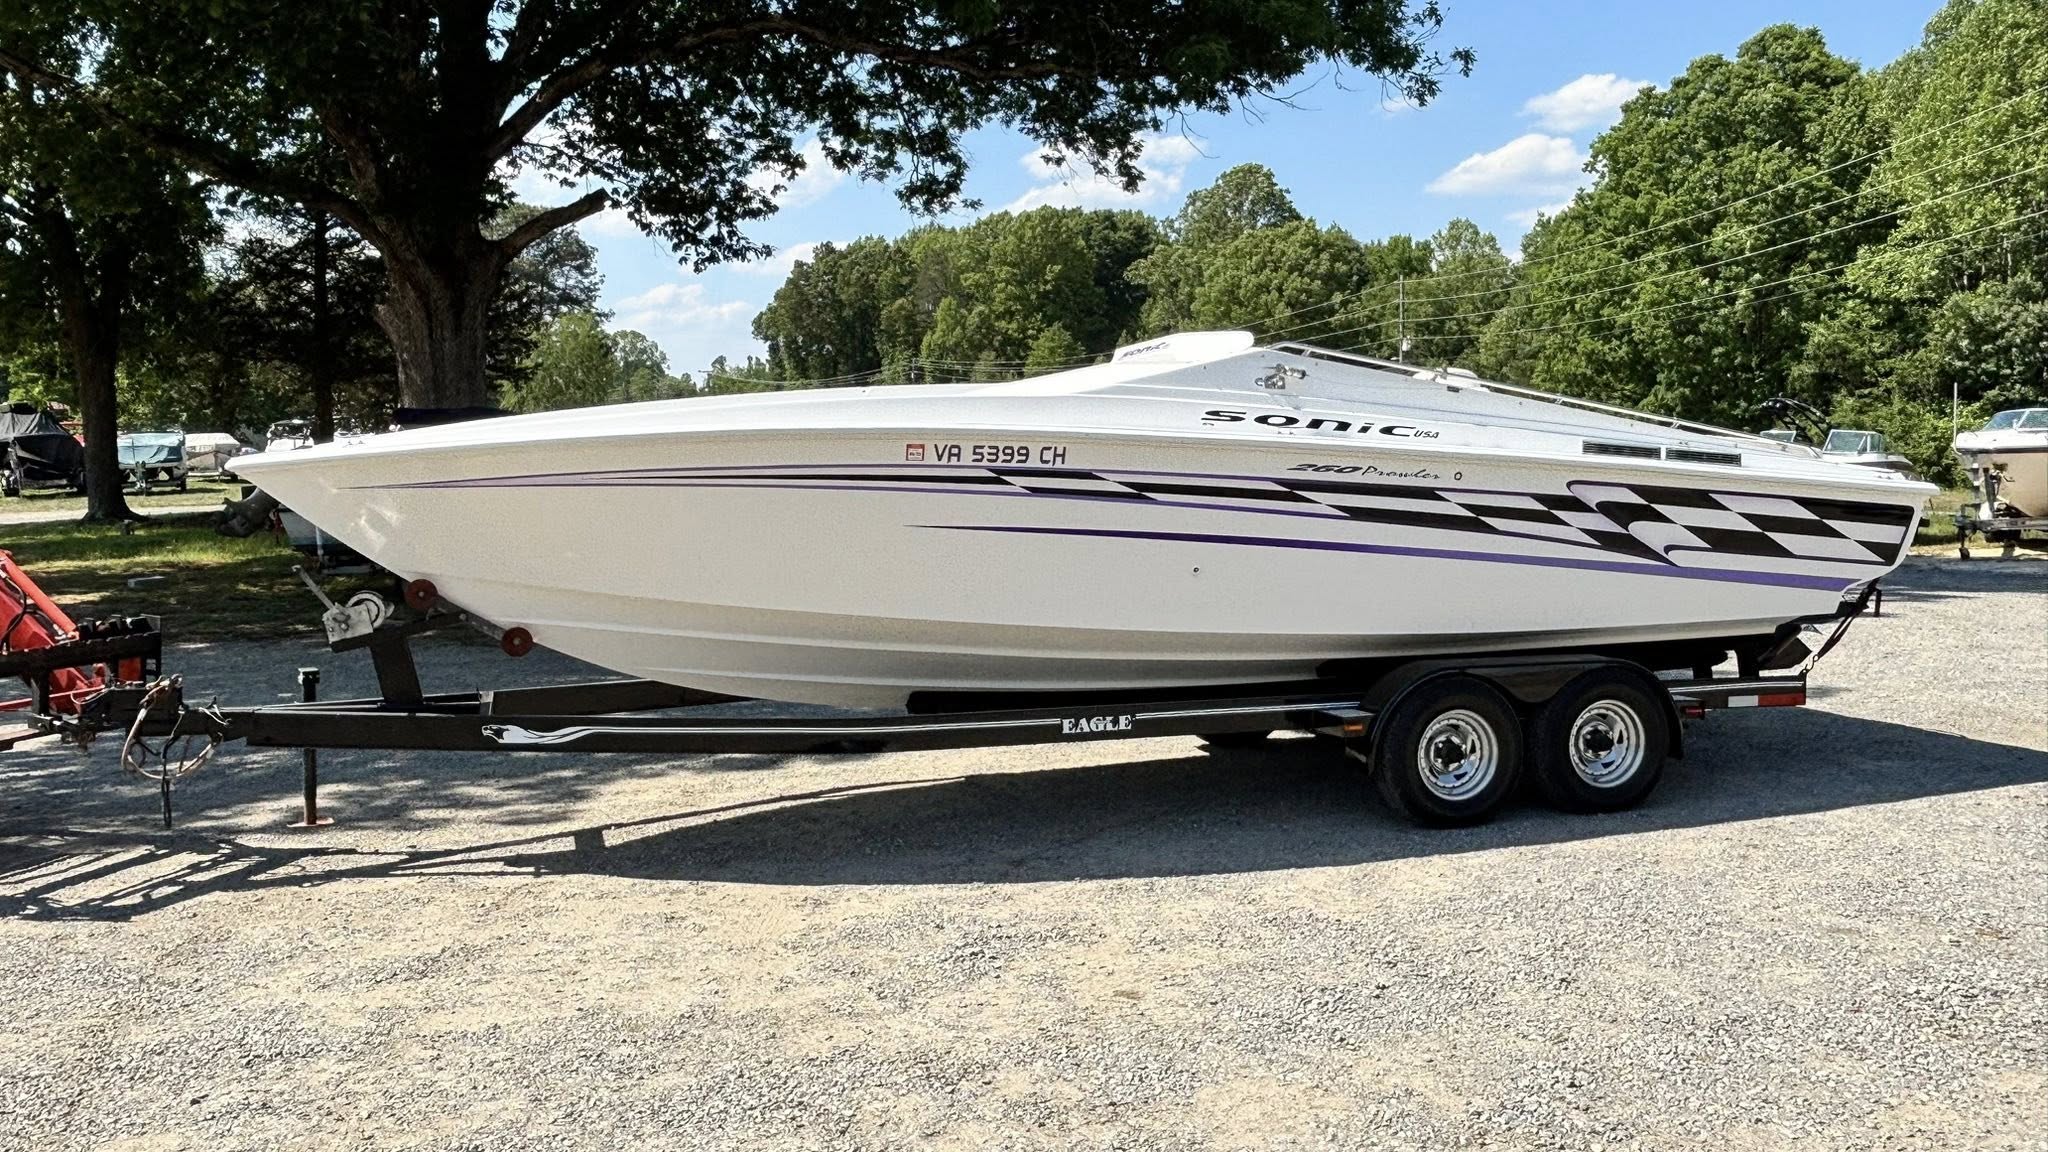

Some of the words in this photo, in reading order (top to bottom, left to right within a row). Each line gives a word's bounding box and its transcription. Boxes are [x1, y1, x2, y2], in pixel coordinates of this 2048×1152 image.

[1414, 430, 1439, 438] USA
[934, 443, 961, 463] VA
[971, 445, 1030, 463] 5399
[1039, 446, 1067, 466] CH
[1286, 463, 1363, 474] 260
[1061, 715, 1132, 733] EAGLE
